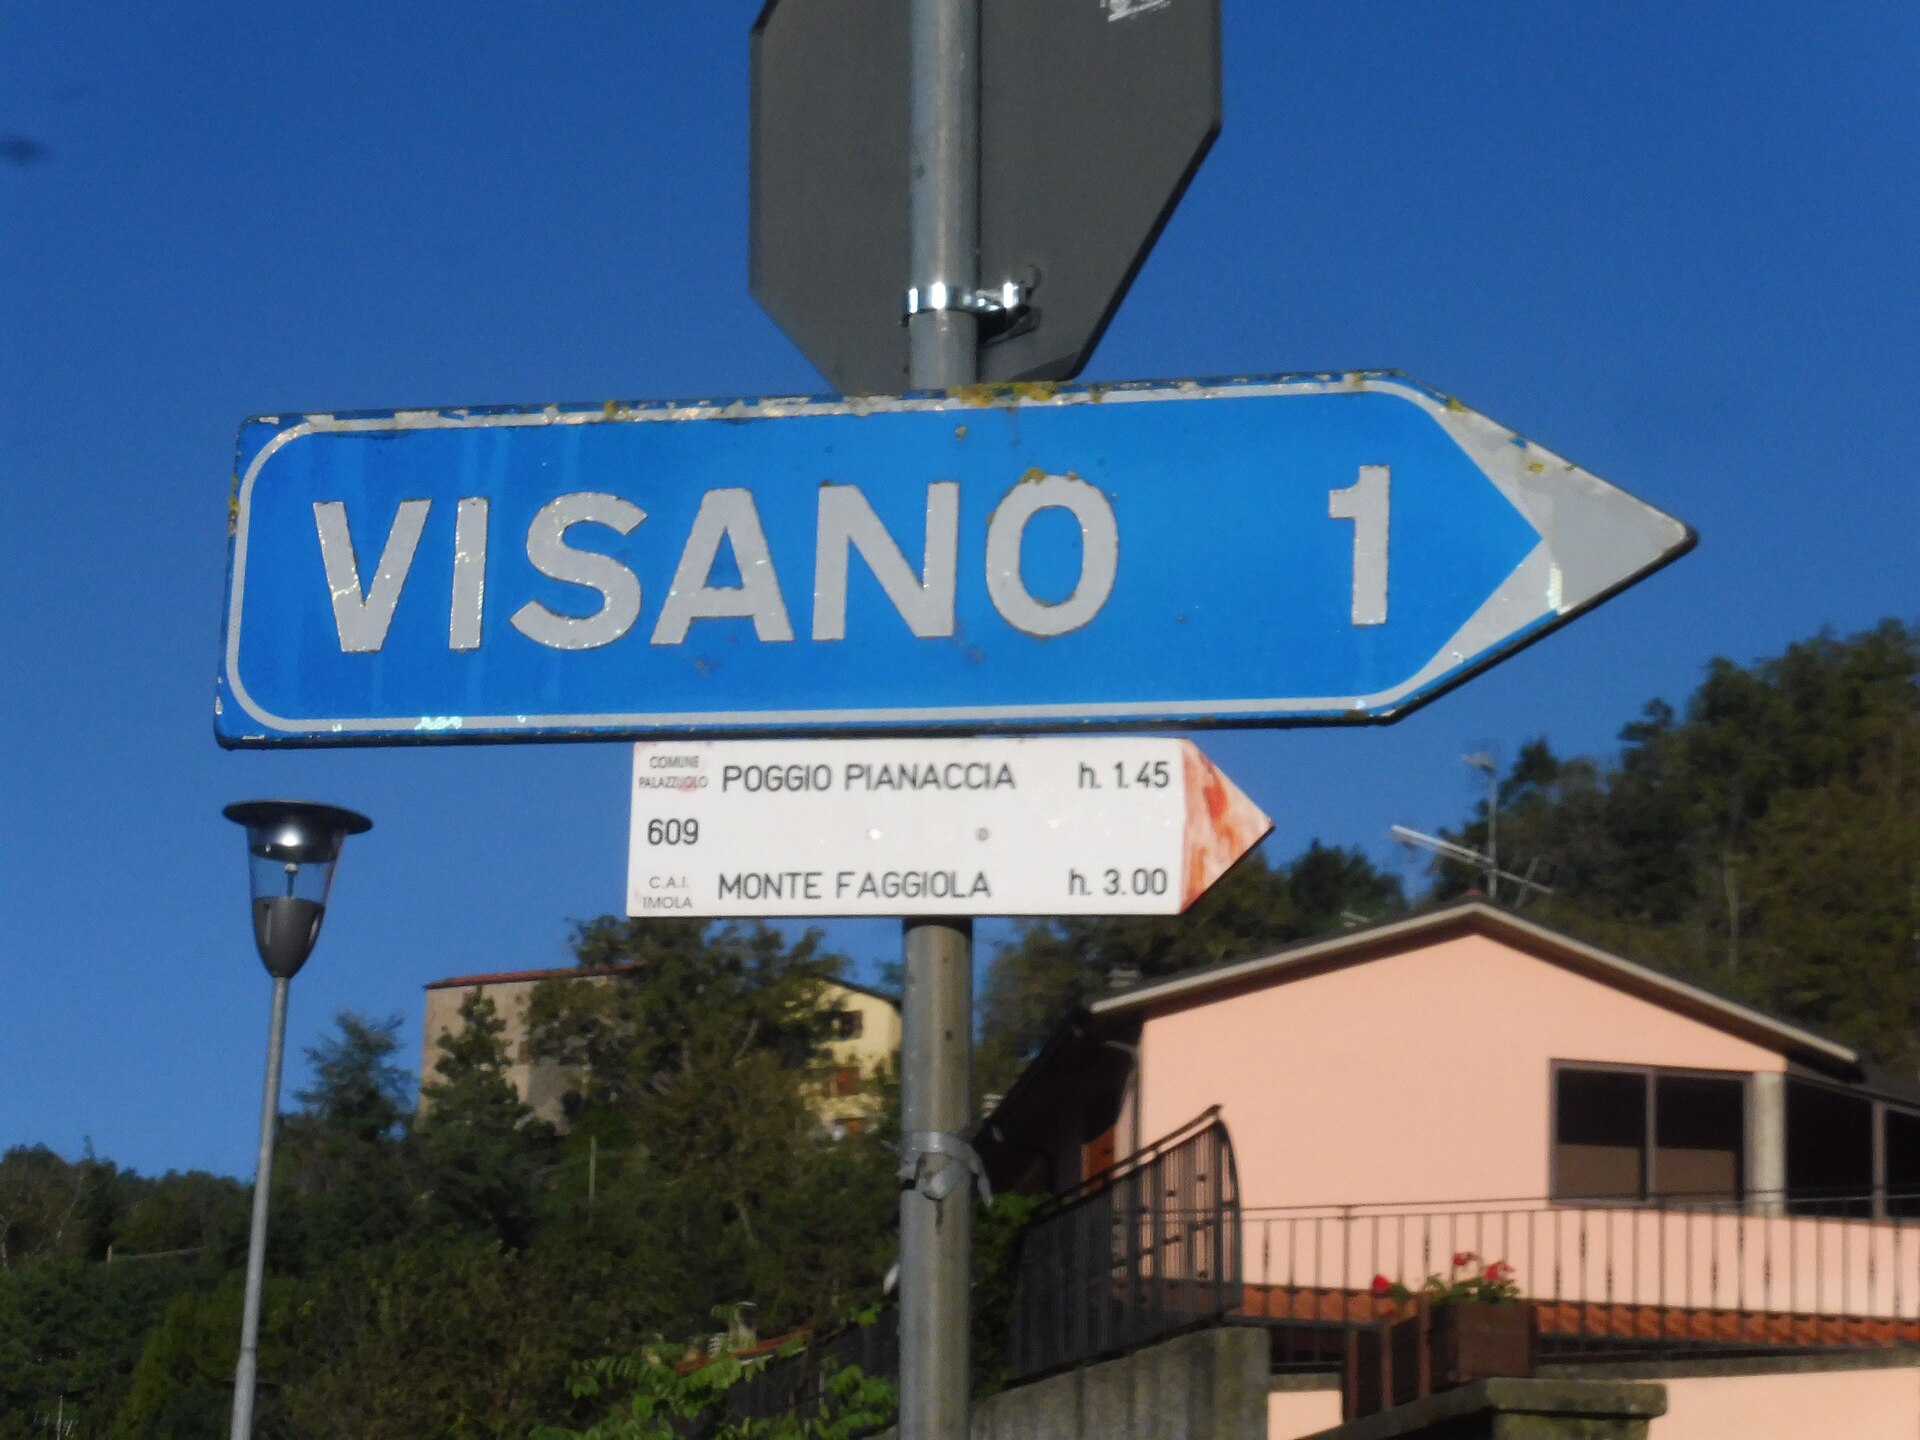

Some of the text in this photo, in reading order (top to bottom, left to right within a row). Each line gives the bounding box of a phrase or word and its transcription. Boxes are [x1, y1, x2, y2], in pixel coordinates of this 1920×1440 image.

[312, 464, 1391, 653] VISANO 1
[650, 756, 699, 769] COMUNE
[638, 775, 708, 789] PALAZZUOLO
[722, 761, 1170, 792] POGGIO PIANACCIA h. 1.45
[647, 818, 699, 846] 609
[649, 876, 689, 889] C.A.I.
[718, 868, 1168, 900] MONTE FAGGIOLA h. 3.00
[642, 896, 692, 909] IMOLA
